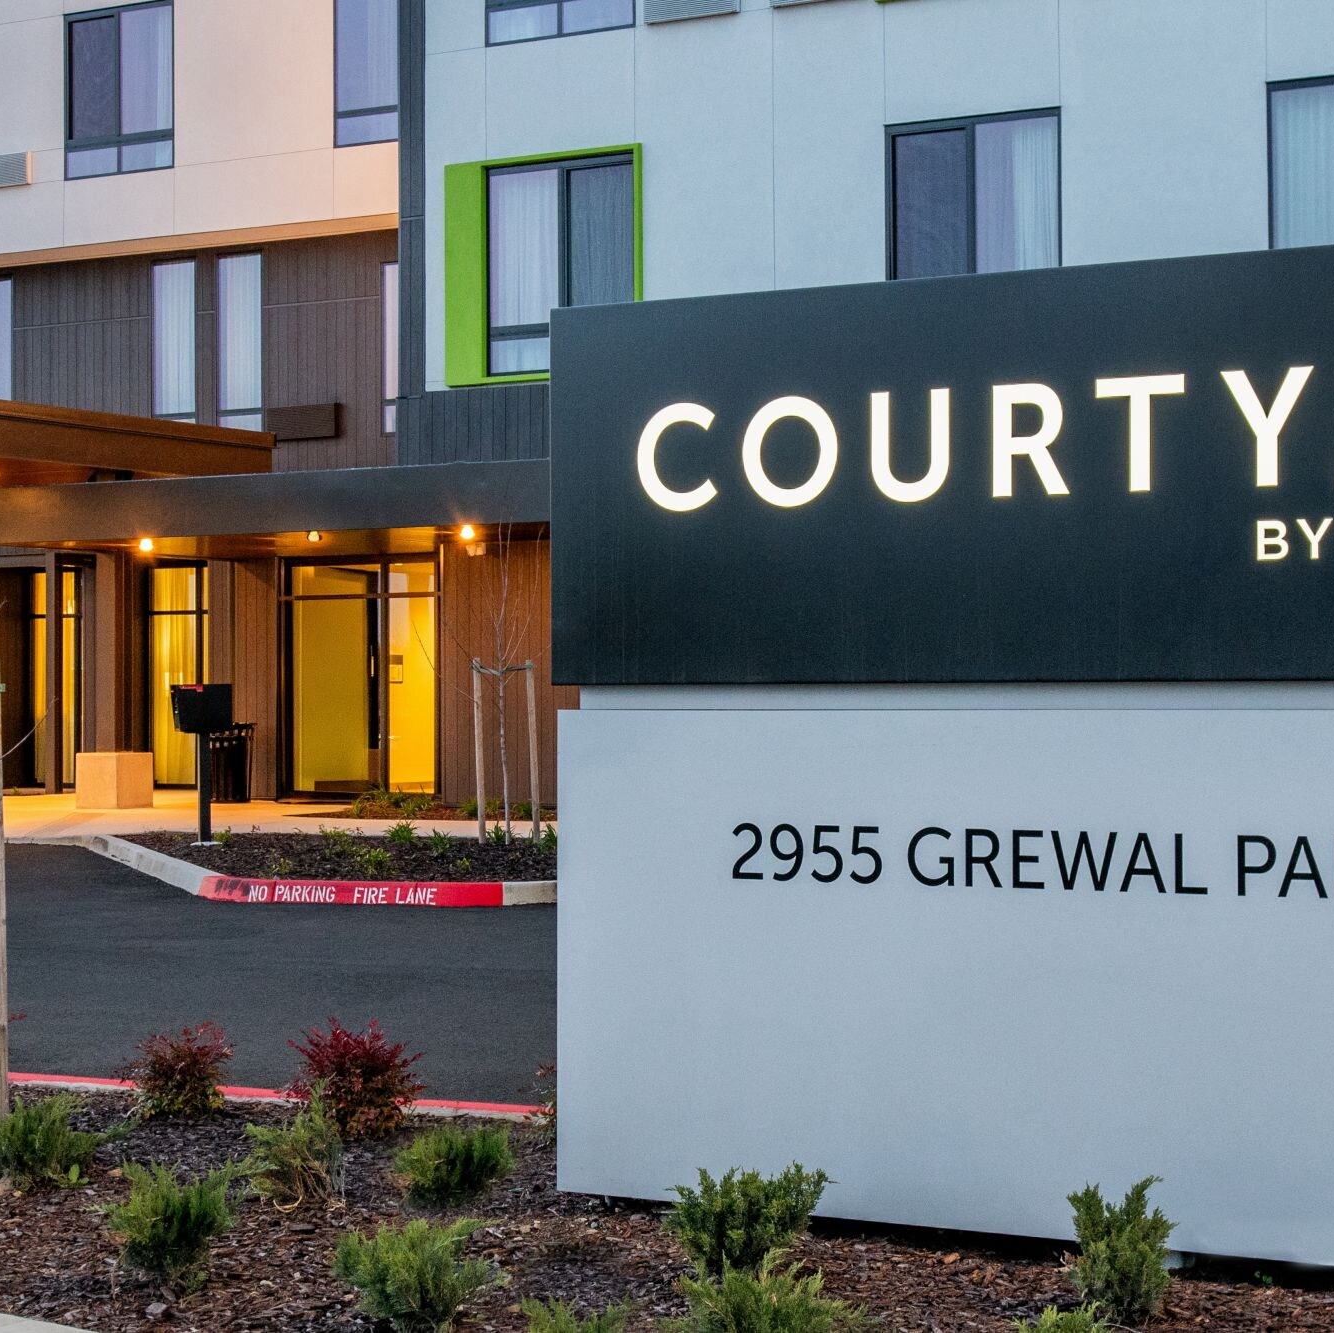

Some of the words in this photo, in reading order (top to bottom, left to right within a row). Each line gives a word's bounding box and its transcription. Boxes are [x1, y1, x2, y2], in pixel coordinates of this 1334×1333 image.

[1256, 517, 1334, 561] BY
[731, 821, 884, 885] 2955
[906, 825, 1210, 895] GREWAL
[247, 884, 268, 903] NO
[273, 884, 336, 904] PARKING
[353, 886, 388, 905] FIRE
[395, 887, 438, 906] LANE
